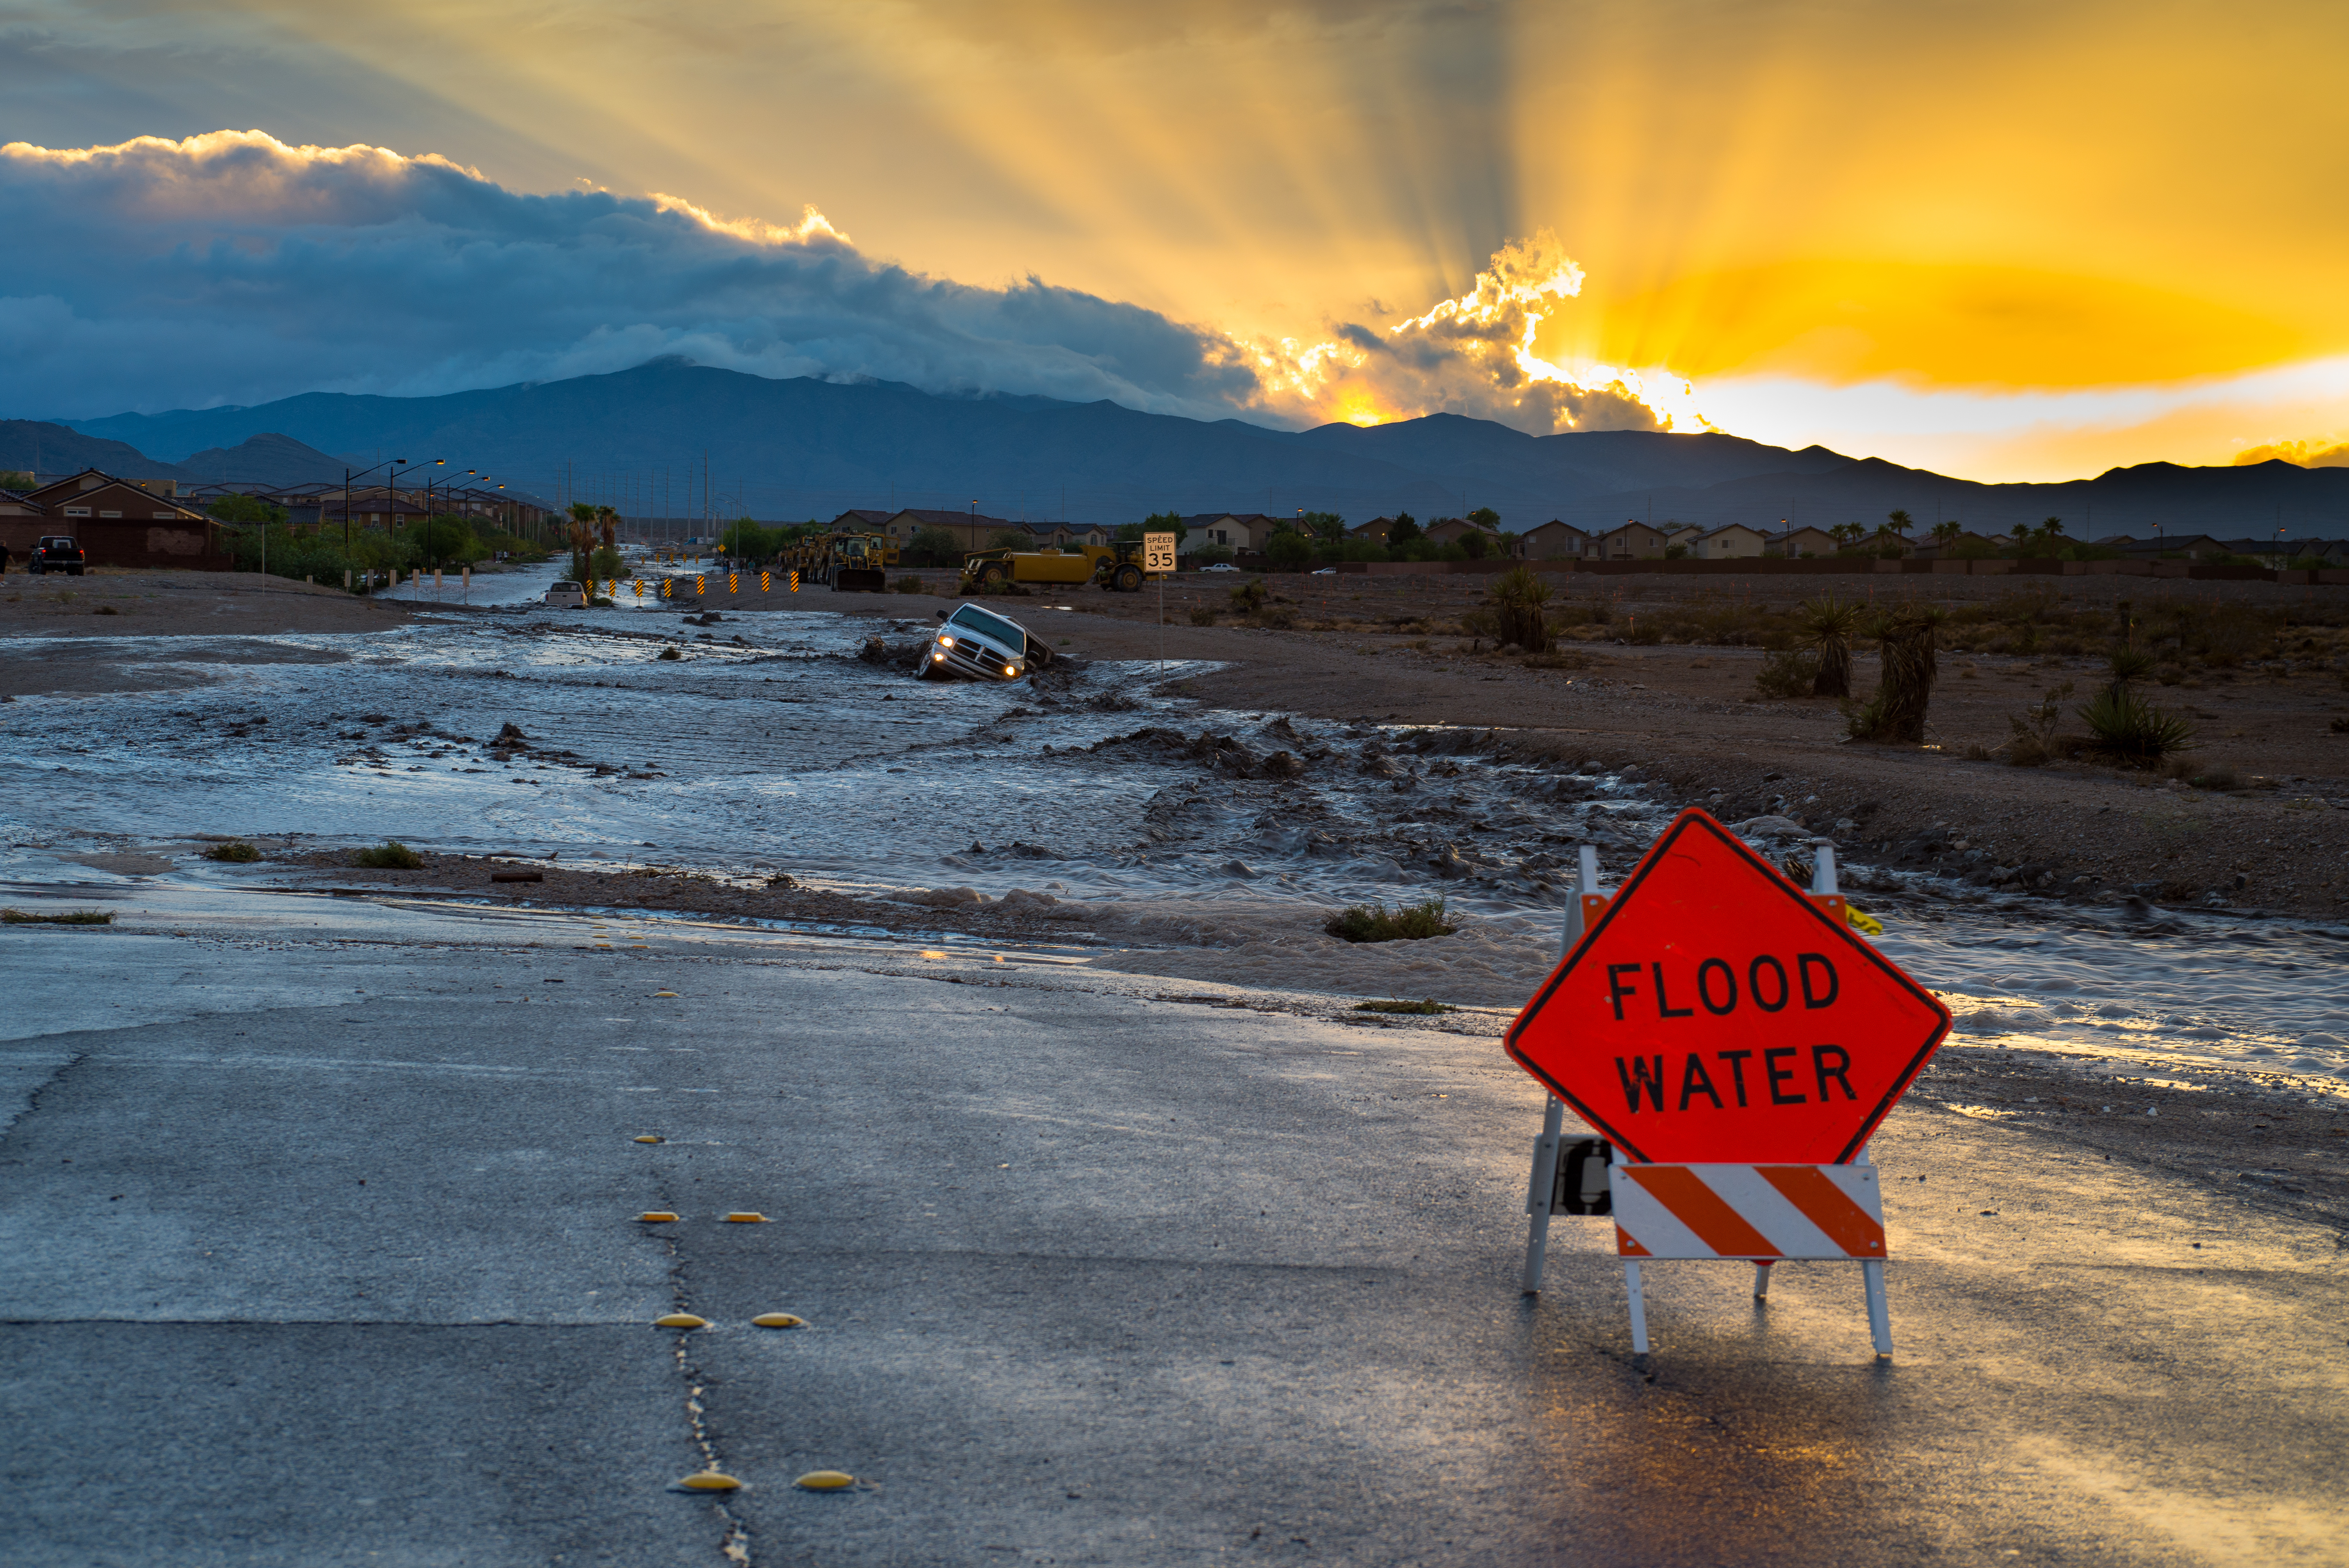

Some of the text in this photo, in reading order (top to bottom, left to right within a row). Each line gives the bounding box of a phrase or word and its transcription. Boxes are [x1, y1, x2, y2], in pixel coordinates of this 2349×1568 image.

[1148, 552, 1173, 567] 35
[1606, 951, 1839, 1021] FLOOD
[1614, 1044, 1858, 1114] WATER
